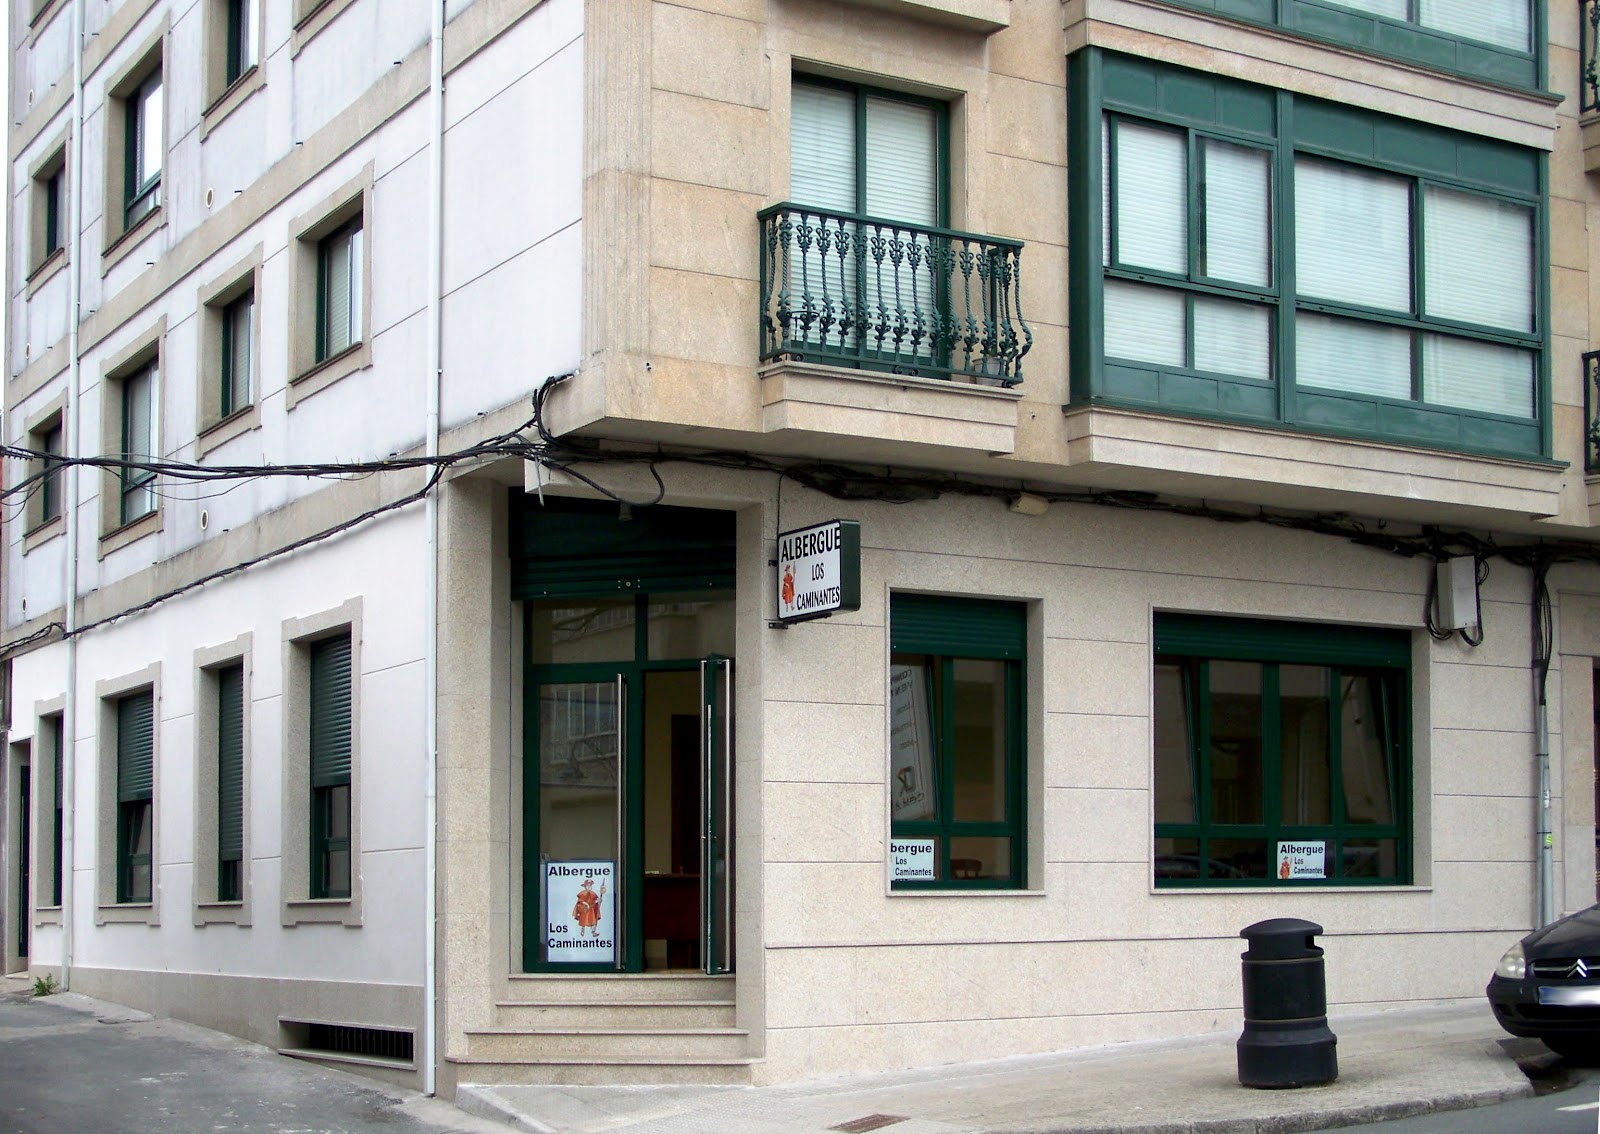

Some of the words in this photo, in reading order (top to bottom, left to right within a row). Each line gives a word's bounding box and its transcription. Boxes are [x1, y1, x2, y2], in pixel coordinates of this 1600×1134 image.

[781, 527, 841, 562] ALBERGUE
[811, 562, 825, 581] LOS
[796, 586, 840, 611] CAMINANTES
[1280, 844, 1324, 856] Albergue
[895, 856, 908, 865] Los
[1294, 857, 1304, 865] Los
[548, 866, 611, 878] Albergue
[895, 867, 932, 876] Caminantes
[1293, 866, 1323, 874] Caminantes
[549, 922, 569, 933] Los
[548, 938, 613, 948] Caminantes
